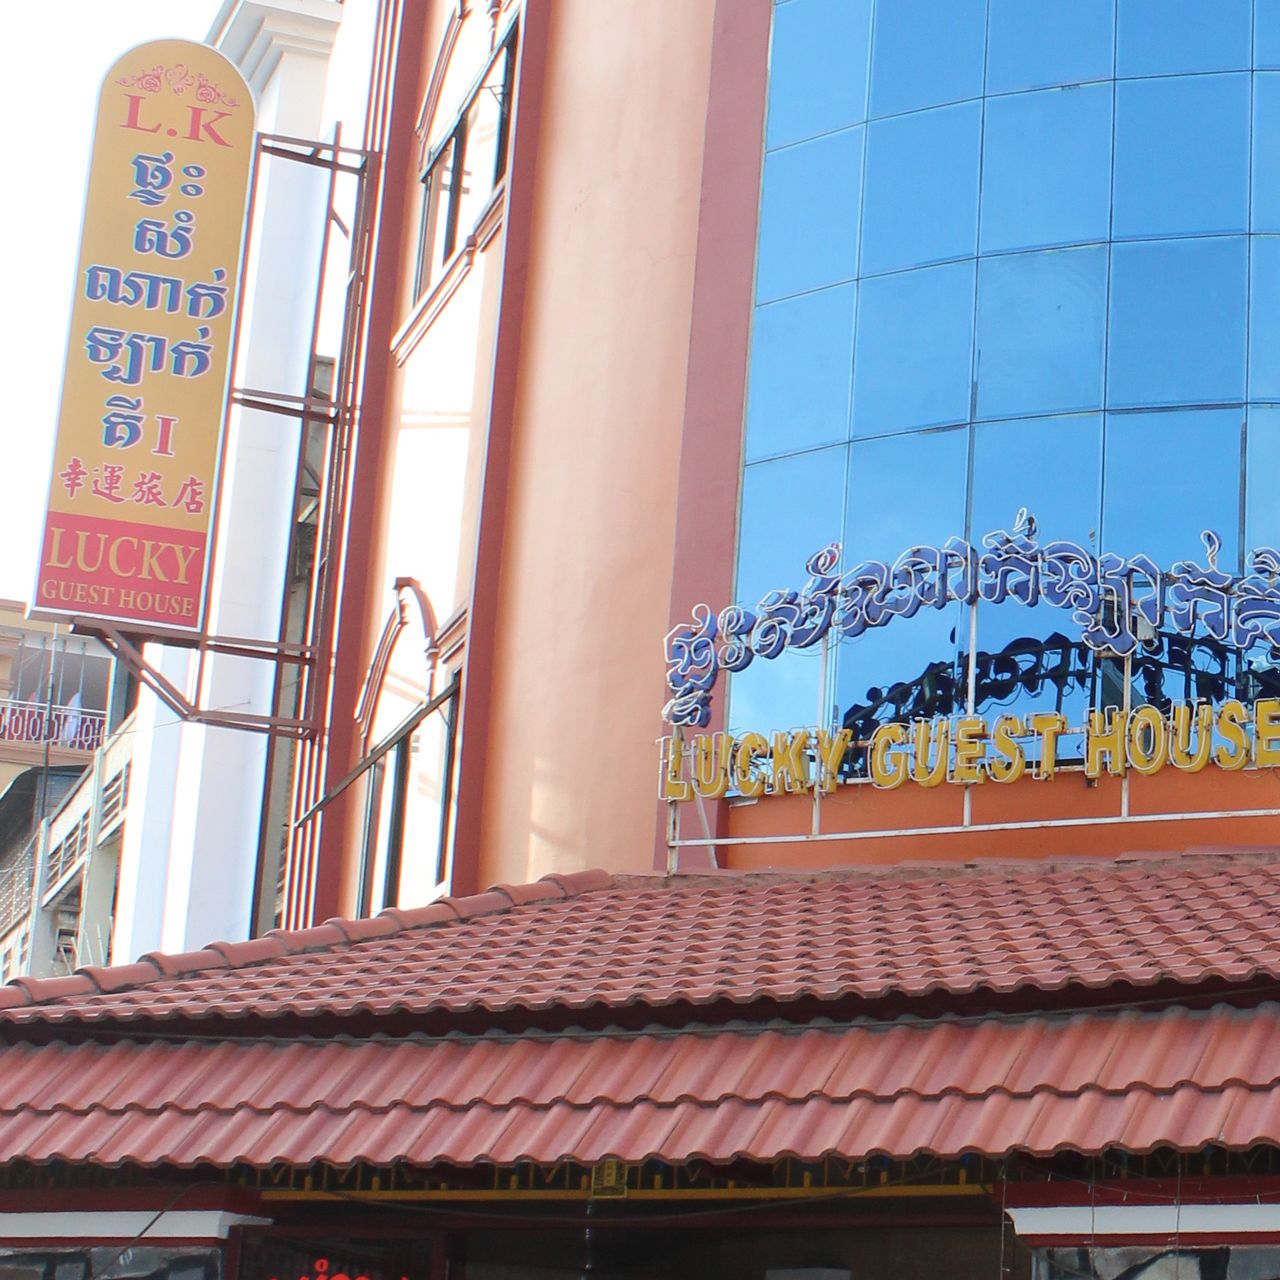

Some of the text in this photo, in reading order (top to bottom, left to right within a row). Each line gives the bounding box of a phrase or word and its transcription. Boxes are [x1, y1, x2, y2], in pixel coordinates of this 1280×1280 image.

[60, 457, 204, 513] 幸運旅店
[45, 527, 200, 585] LUCKY
[42, 579, 194, 617] GUEST HOUSE
[656, 726, 852, 803] LUCKY
[868, 713, 1069, 790] GUEST
